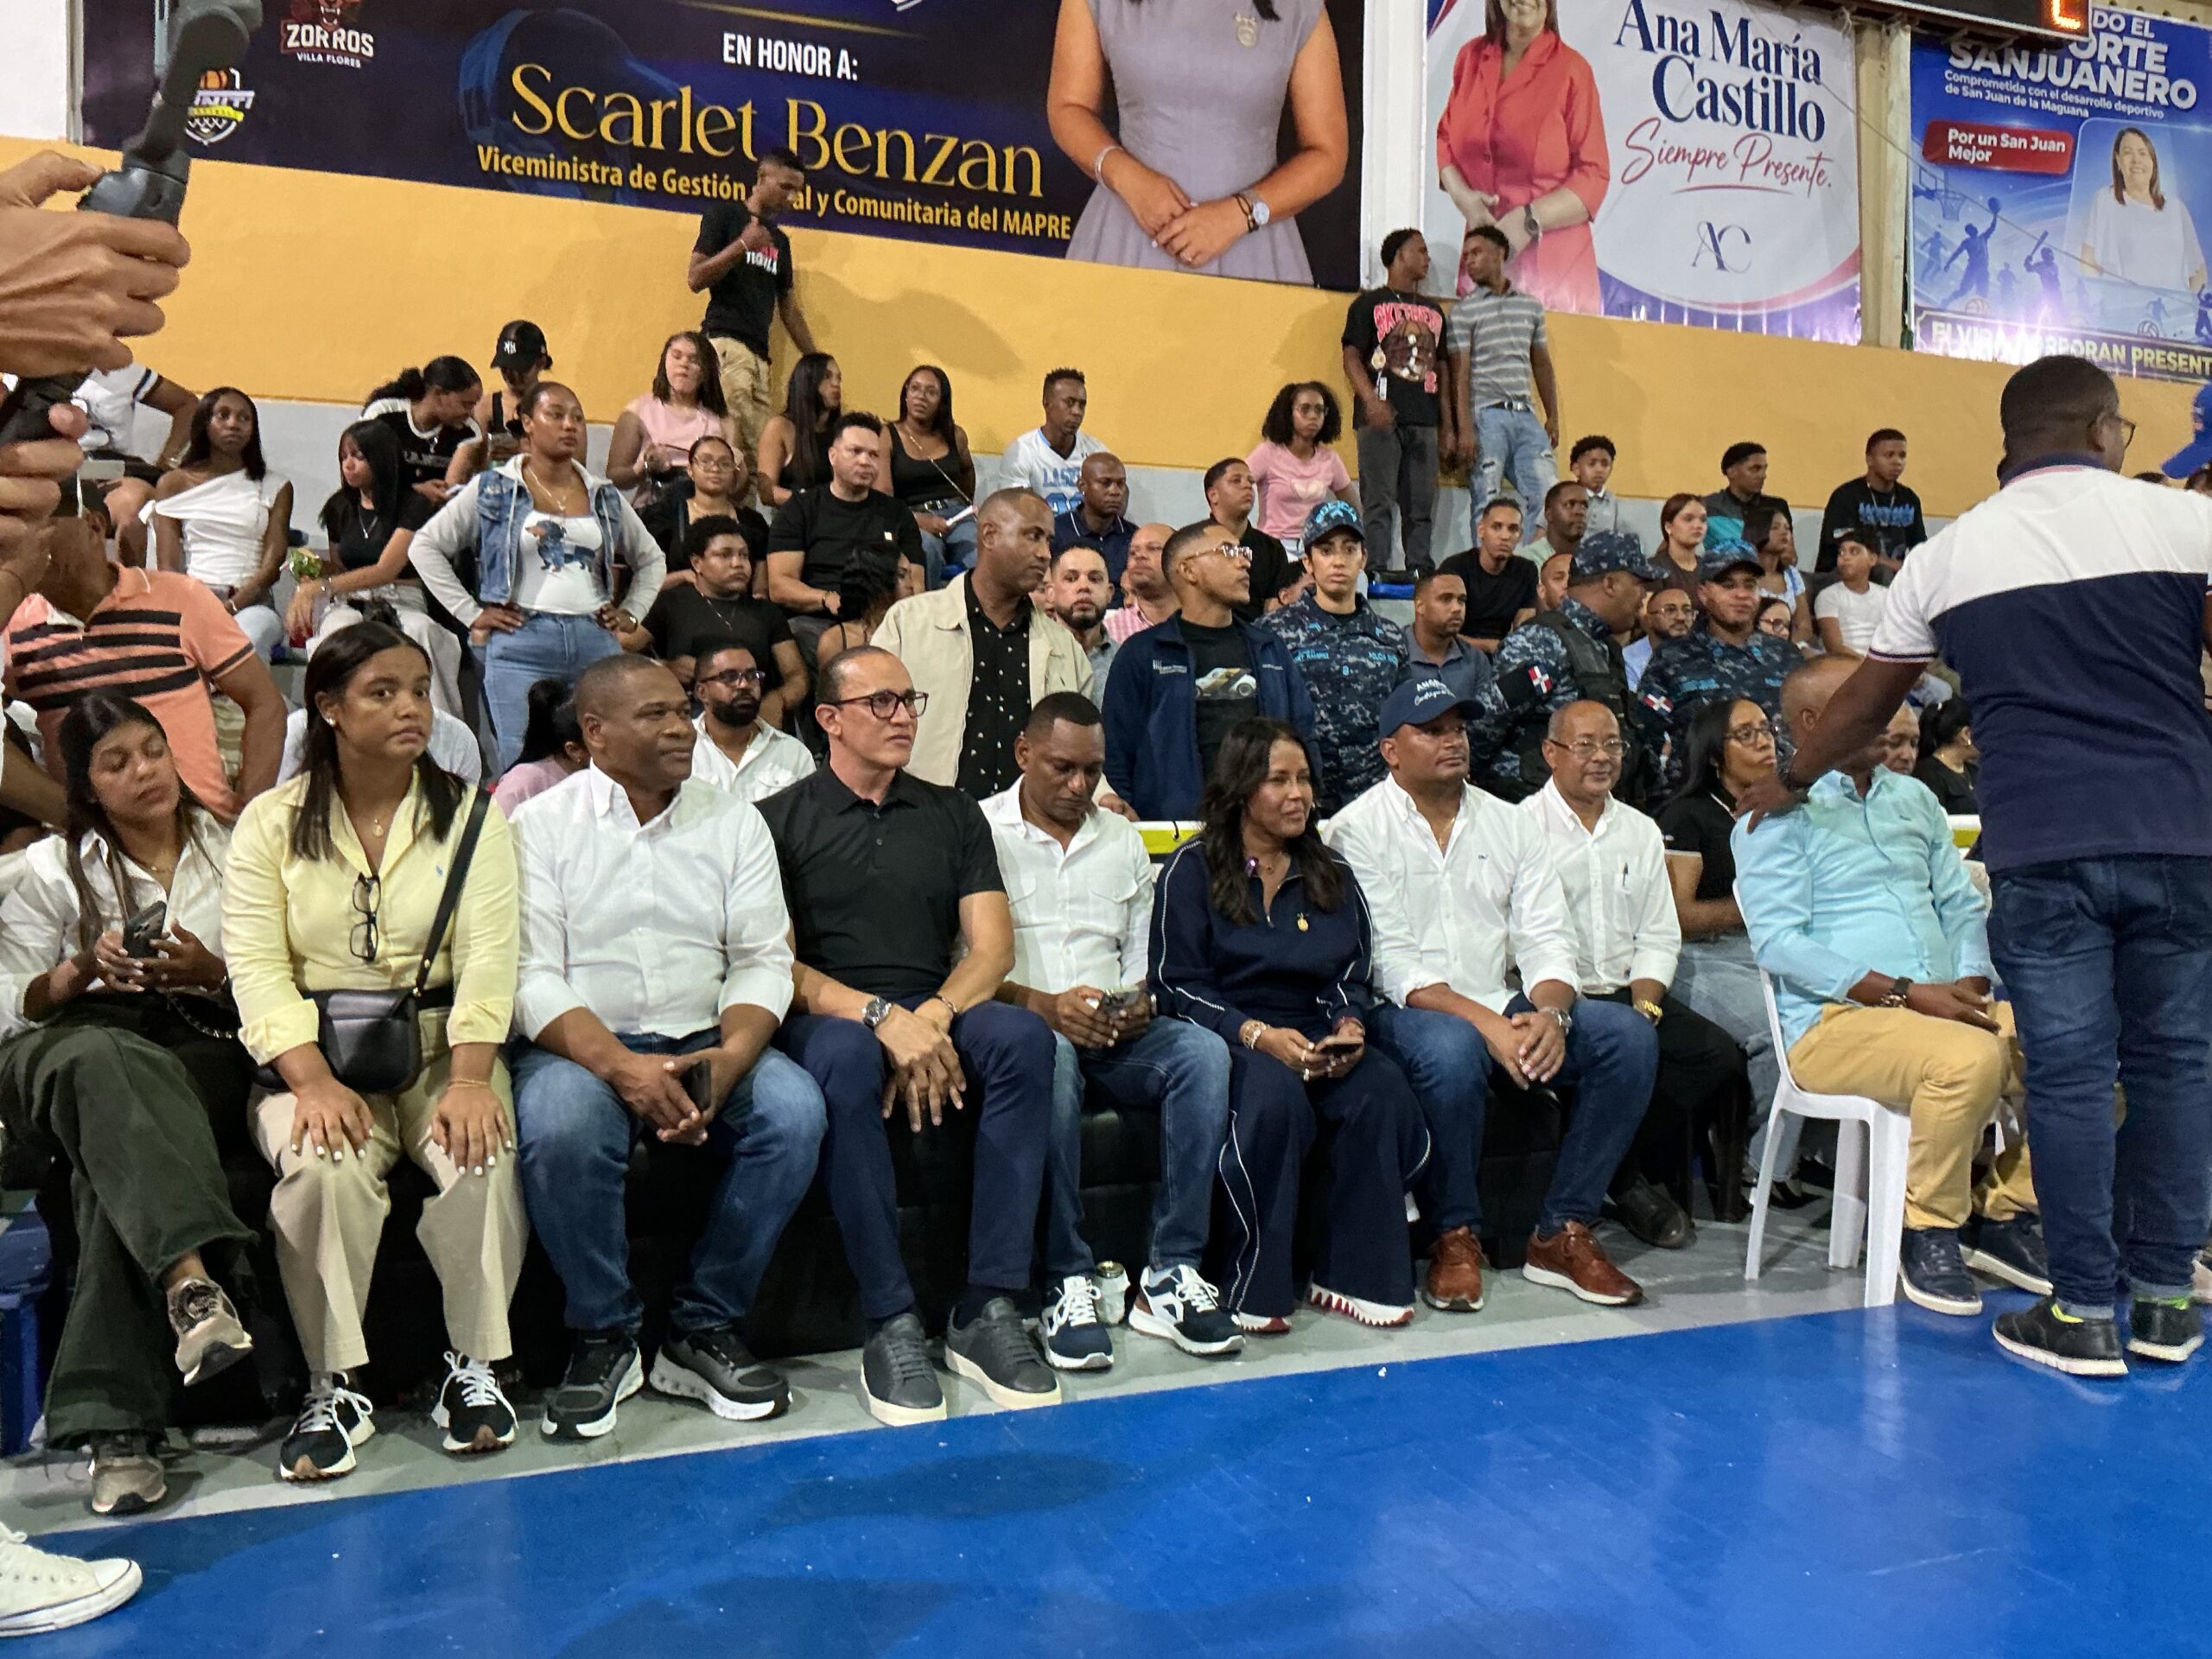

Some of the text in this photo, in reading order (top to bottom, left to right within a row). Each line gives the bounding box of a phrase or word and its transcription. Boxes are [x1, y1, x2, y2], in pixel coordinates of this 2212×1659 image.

[286, 24, 374, 58] ZORROS
[1613, 0, 1823, 86] Ana María
[2131, 18, 2155, 39] EL
[297, 53, 362, 68] VILLA FLORES
[723, 32, 858, 81] EN HONOR A:
[1948, 40, 2197, 111] SANJUANERO
[1653, 54, 1825, 143] Castillo
[1944, 69, 2164, 119] Comprometida con el desarrollo deportivo
[1944, 83, 2089, 118] de San Juan de la Maguana
[512, 63, 1044, 198] Scarlet Benzan
[1948, 129, 2066, 153] Por un San Juan
[1948, 145, 1993, 164] Mejor
[1621, 117, 1834, 198] Siempre Presente.
[477, 144, 623, 187] Viceministra
[629, 162, 657, 191] de
[663, 168, 747, 201] Gestión
[817, 192, 830, 218] y
[834, 189, 962, 228] Comunitaria
[967, 205, 997, 232] del
[1003, 209, 1071, 240] MAPRE
